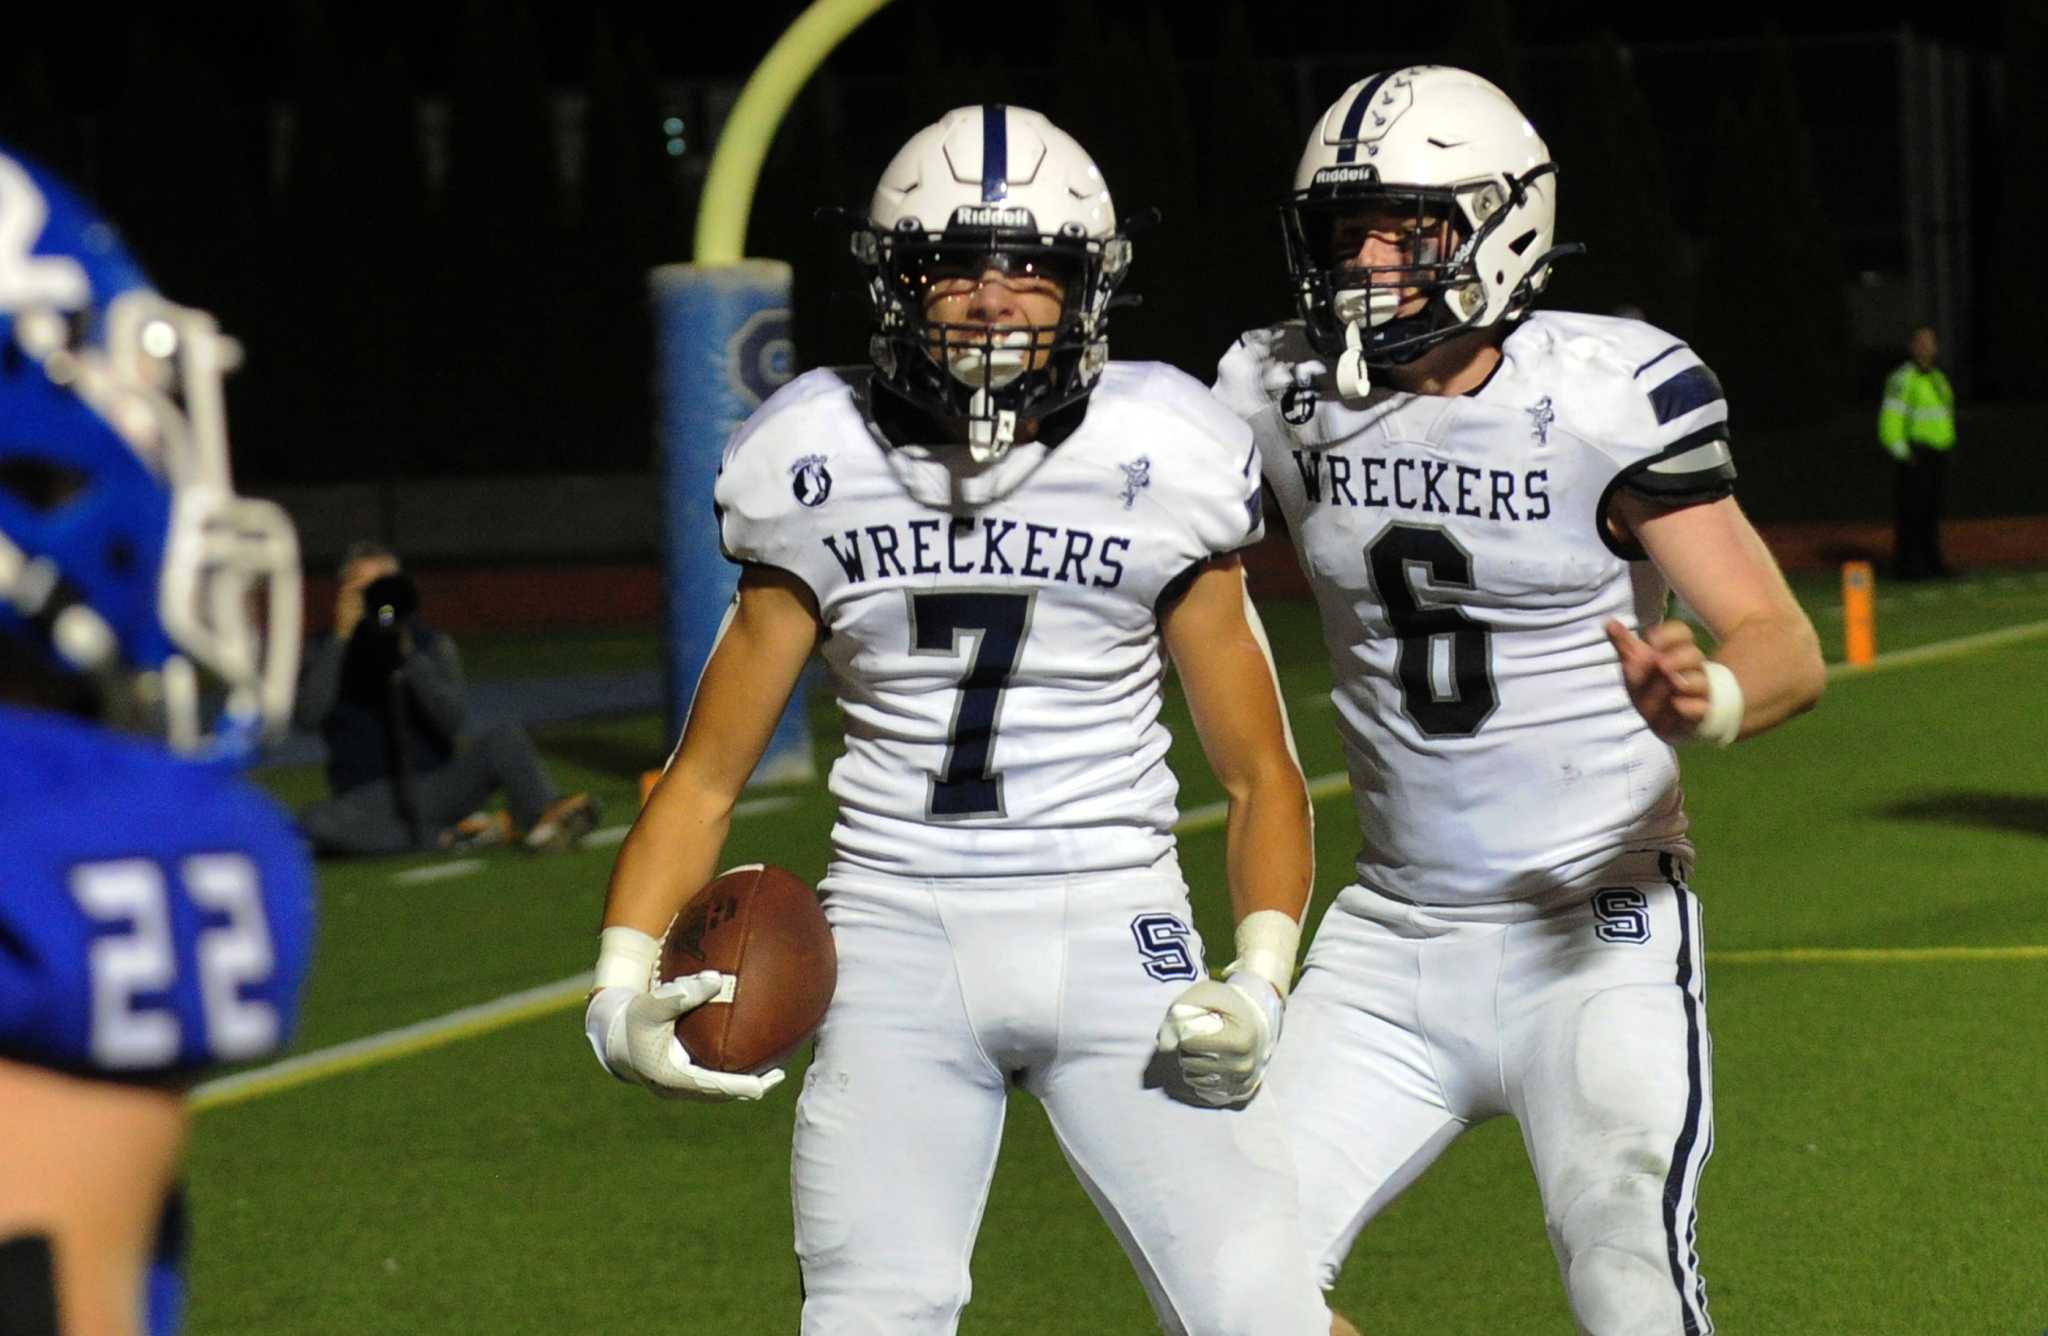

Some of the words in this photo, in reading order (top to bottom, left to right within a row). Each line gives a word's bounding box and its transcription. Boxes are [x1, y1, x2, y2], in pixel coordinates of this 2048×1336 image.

[957, 206, 1028, 226] Riddell
[1293, 450, 1551, 521] WRECKERS
[822, 517, 1131, 588] WRECKERS
[1363, 519, 1501, 741] 6
[904, 585, 1039, 821] 7
[1130, 912, 1198, 983] S
[1590, 887, 1652, 945] S
[68, 852, 281, 1070] 22
